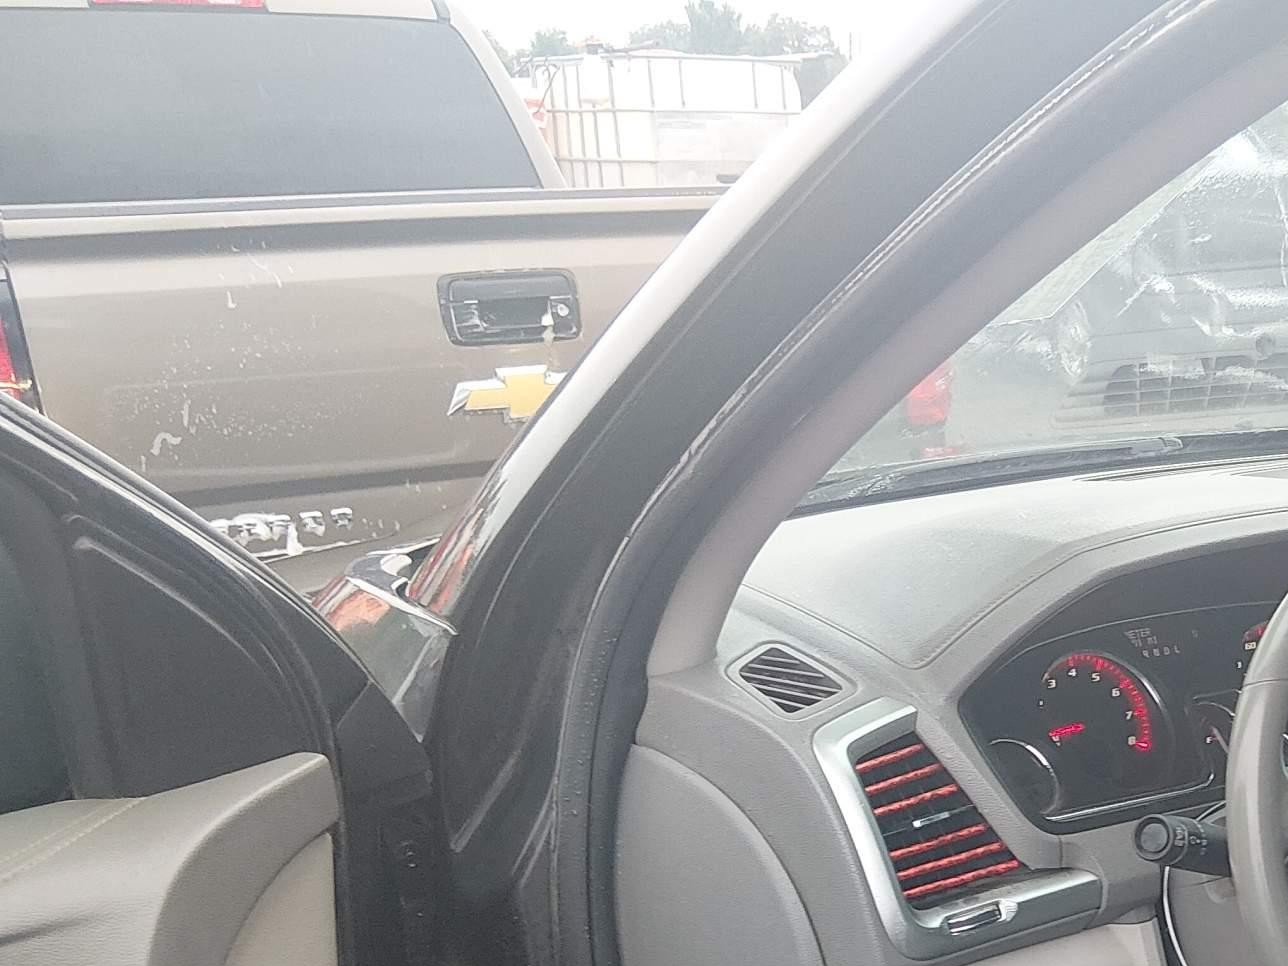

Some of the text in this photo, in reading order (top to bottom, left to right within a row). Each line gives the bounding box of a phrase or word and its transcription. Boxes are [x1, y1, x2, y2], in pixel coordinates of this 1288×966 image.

[1067, 668, 1077, 677] 4
[1091, 672, 1101, 682] 5
[1047, 679, 1057, 689] 3
[1111, 688, 1121, 697] 6
[1125, 711, 1133, 720] 7
